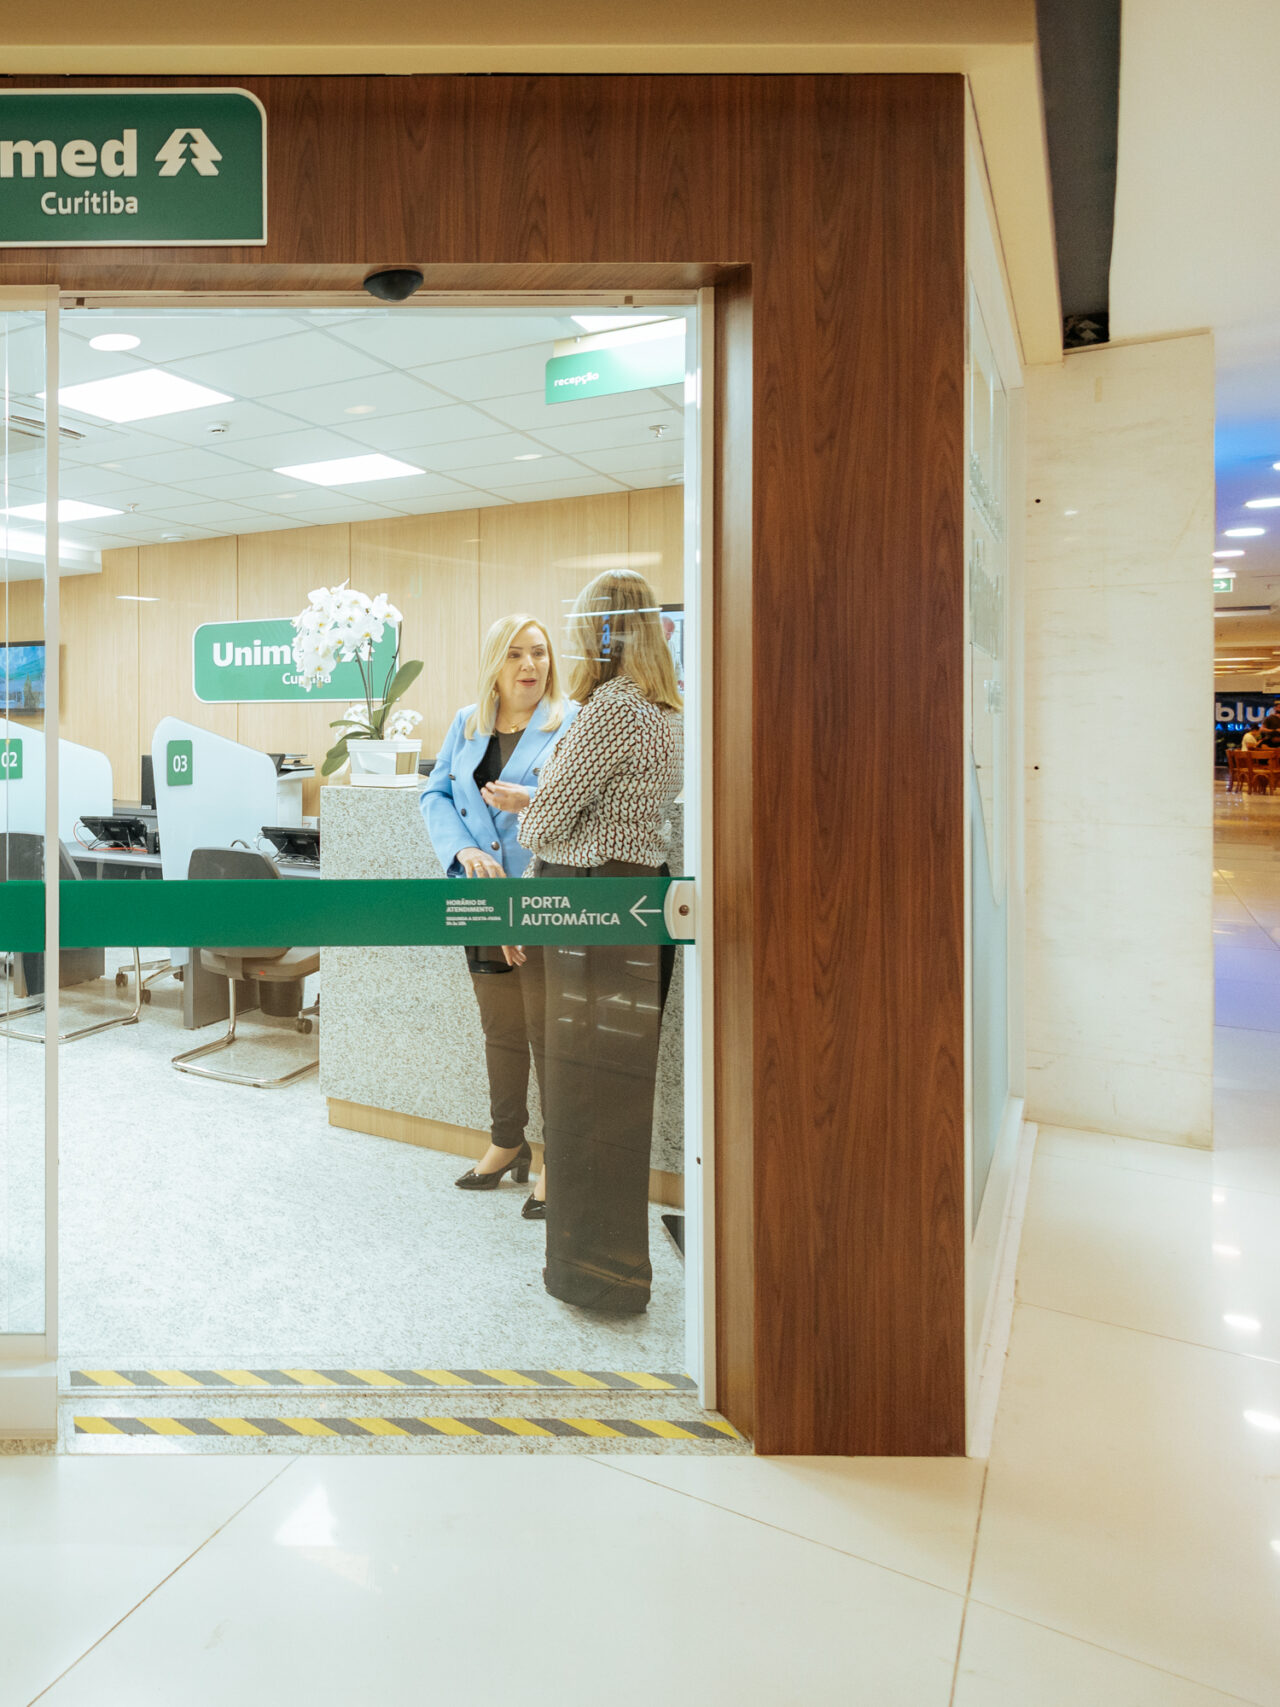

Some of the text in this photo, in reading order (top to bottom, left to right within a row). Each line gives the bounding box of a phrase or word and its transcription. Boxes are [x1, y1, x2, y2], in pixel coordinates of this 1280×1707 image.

[40, 190, 139, 215] Curitiba
[554, 371, 600, 388] recepção
[1, 751, 18, 768] 02
[172, 755, 188, 772] 03
[446, 898, 477, 906] HORÁRIO
[521, 896, 571, 909] PORTA
[520, 909, 621, 926] AUTOMÁTICA
